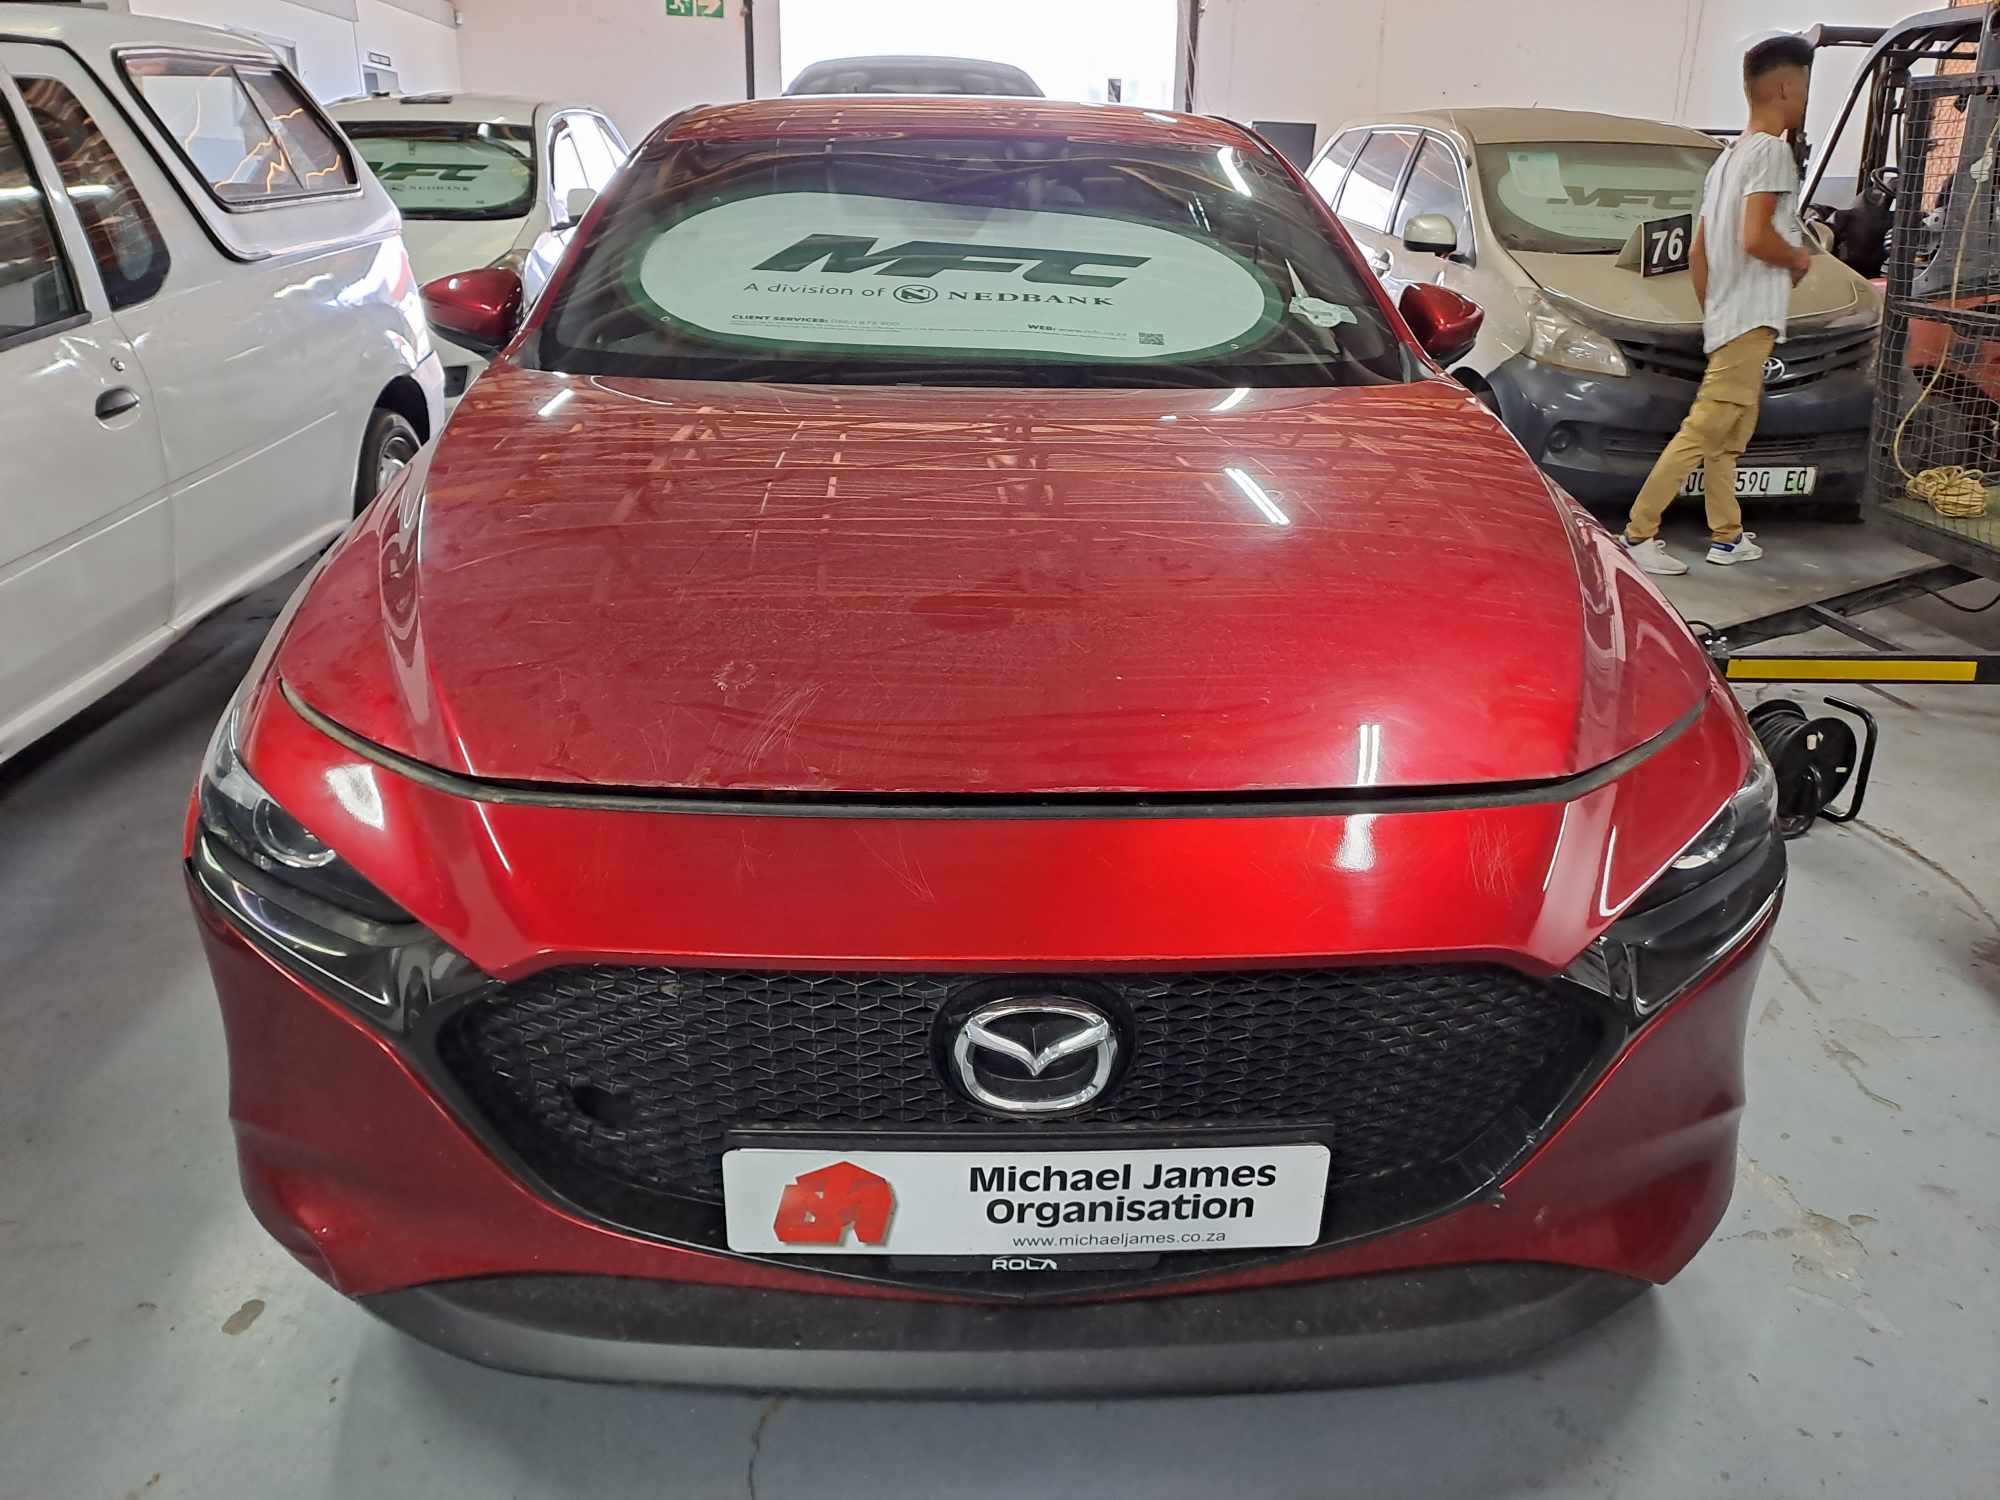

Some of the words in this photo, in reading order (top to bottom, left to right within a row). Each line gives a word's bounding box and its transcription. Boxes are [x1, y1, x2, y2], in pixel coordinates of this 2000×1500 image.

[1546, 186, 1696, 210] MFC
[1651, 227, 1684, 265] 76
[752, 233, 1152, 288] MFC
[744, 282, 759, 292] A
[767, 283, 854, 296] division
[862, 287, 886, 297] of
[948, 290, 1114, 306] NEDBANK
[773, 316, 829, 324] SERVICES:
[1027, 323, 1056, 331] WEB:
[969, 1164, 1131, 1193] Michael
[1143, 1163, 1277, 1190] James
[985, 1194, 1255, 1228] Organisation
[1012, 1231, 1226, 1248] www.michaeljames.co.za
[991, 1256, 1058, 1271] ROLA
